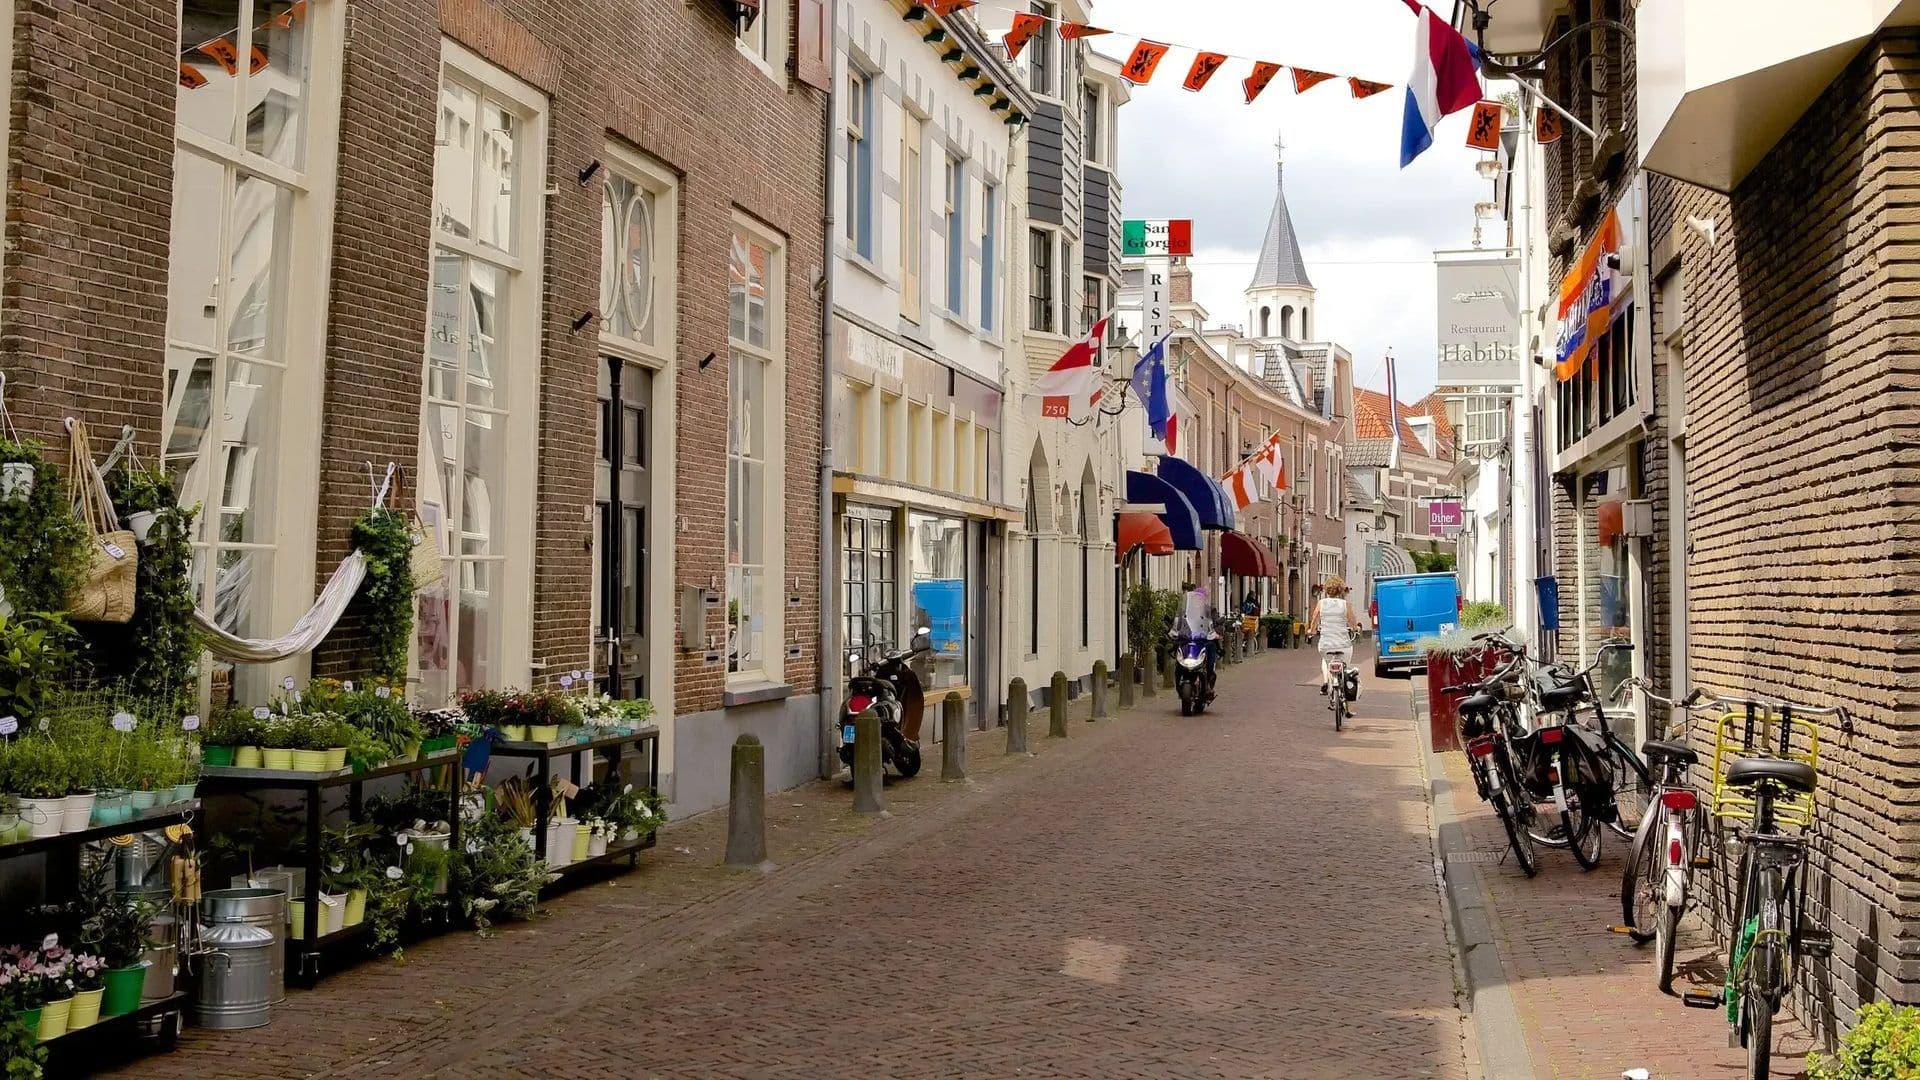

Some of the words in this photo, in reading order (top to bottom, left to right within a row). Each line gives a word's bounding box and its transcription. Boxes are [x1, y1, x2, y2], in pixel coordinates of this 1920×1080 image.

[1144, 223, 1170, 234] San
[1127, 238, 1187, 251] Giorgio
[1451, 324, 1506, 334] Restaurant
[1442, 341, 1513, 361] Habibi
[1045, 405, 1066, 415] 750
[1431, 512, 1455, 523] Diner
